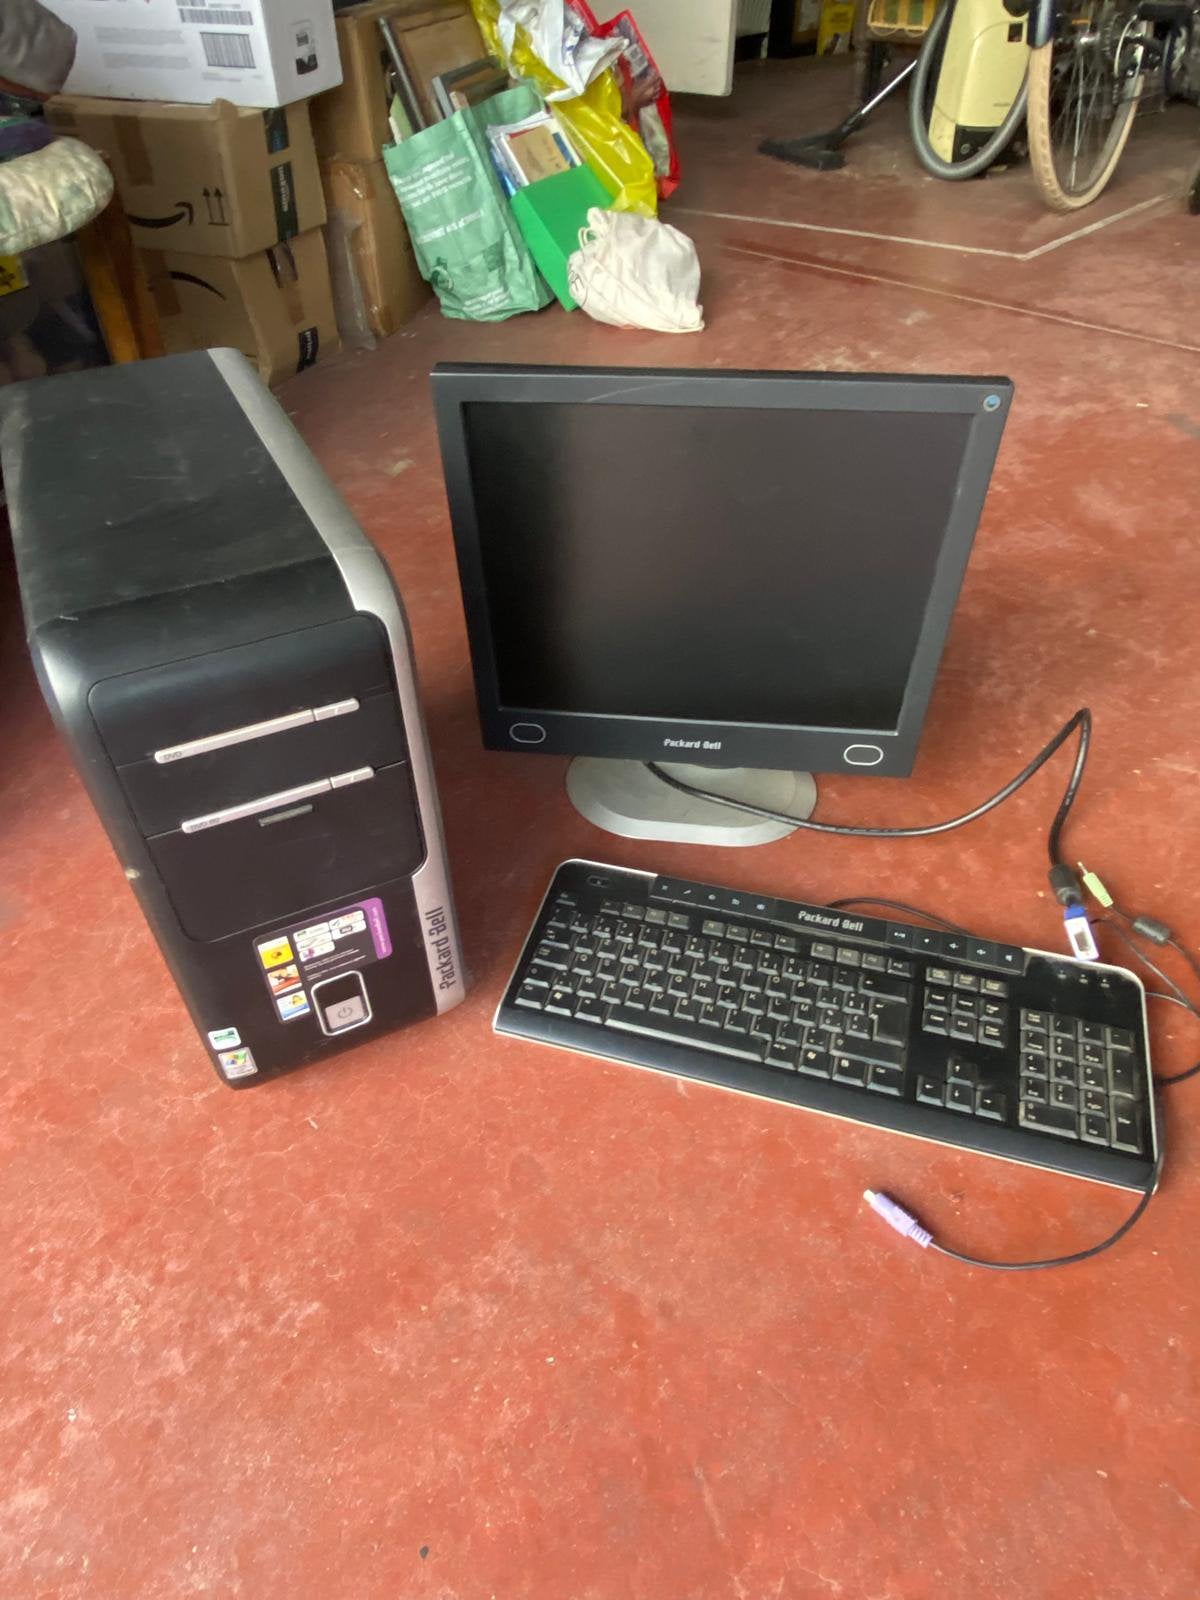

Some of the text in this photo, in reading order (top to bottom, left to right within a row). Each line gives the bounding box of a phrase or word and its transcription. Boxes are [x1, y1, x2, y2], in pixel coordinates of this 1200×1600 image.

[663, 738, 722, 750] Packard Bell
[798, 910, 864, 932] Packard Bell
[424, 906, 457, 990] Packard Bell
